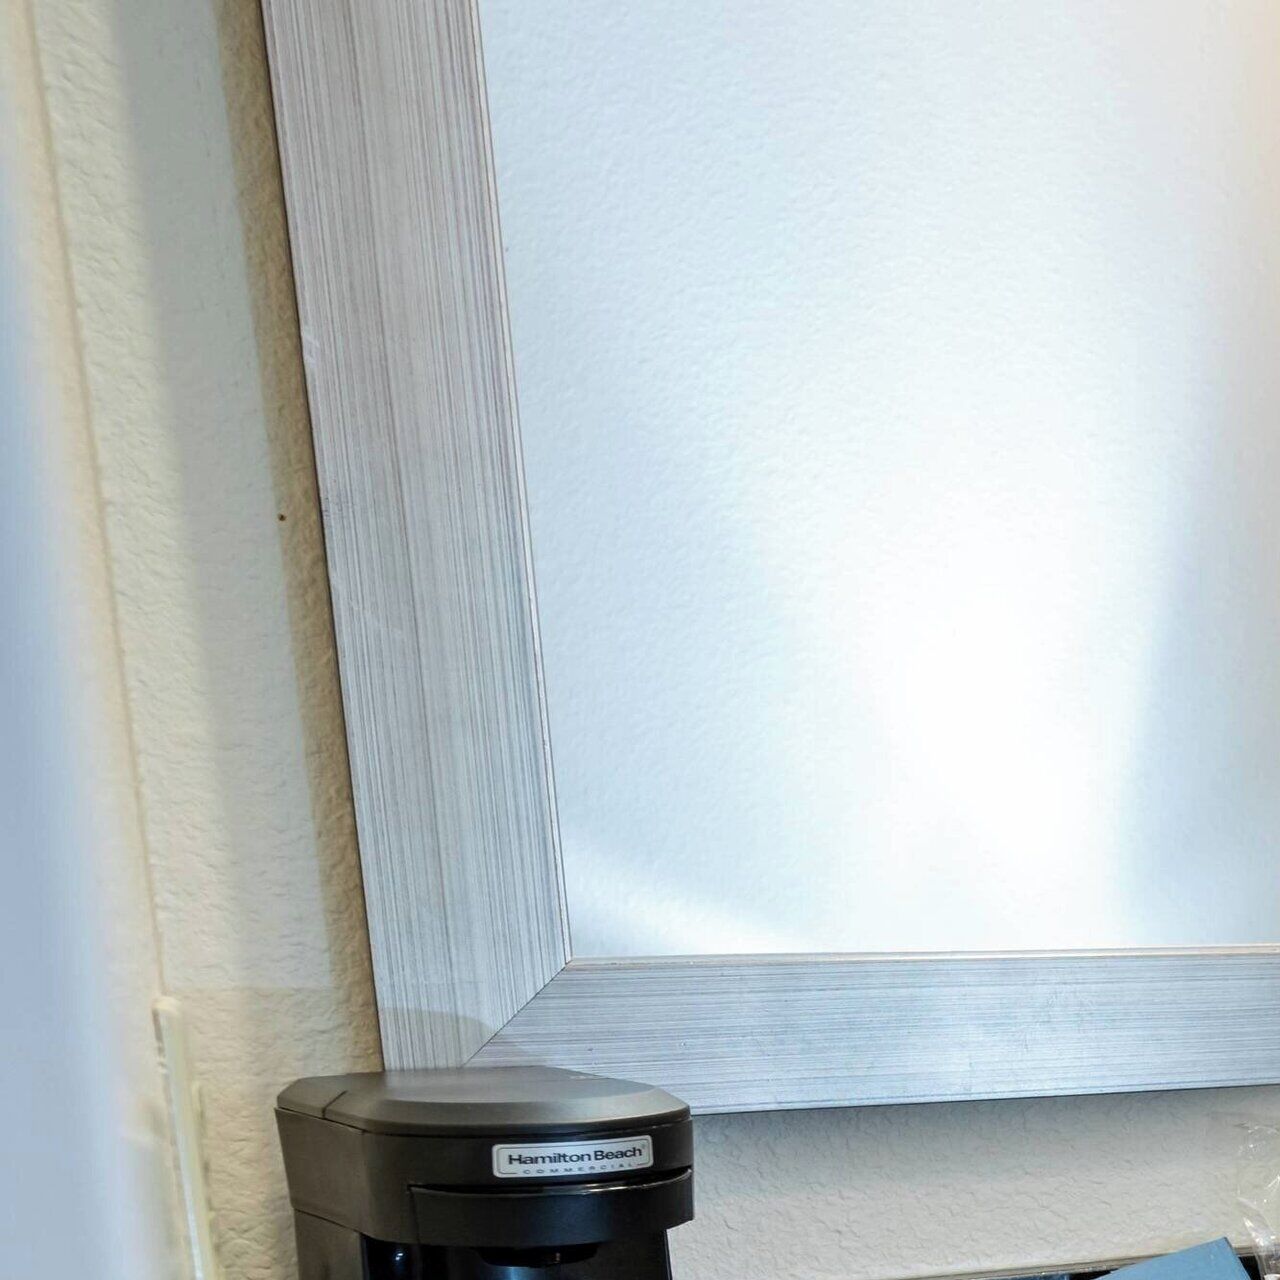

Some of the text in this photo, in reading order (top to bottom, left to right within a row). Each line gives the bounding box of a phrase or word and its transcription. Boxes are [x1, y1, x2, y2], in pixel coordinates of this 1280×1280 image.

[508, 1146, 642, 1165] Hamilton Beach
[523, 1163, 633, 1175] COMMERCIAL
